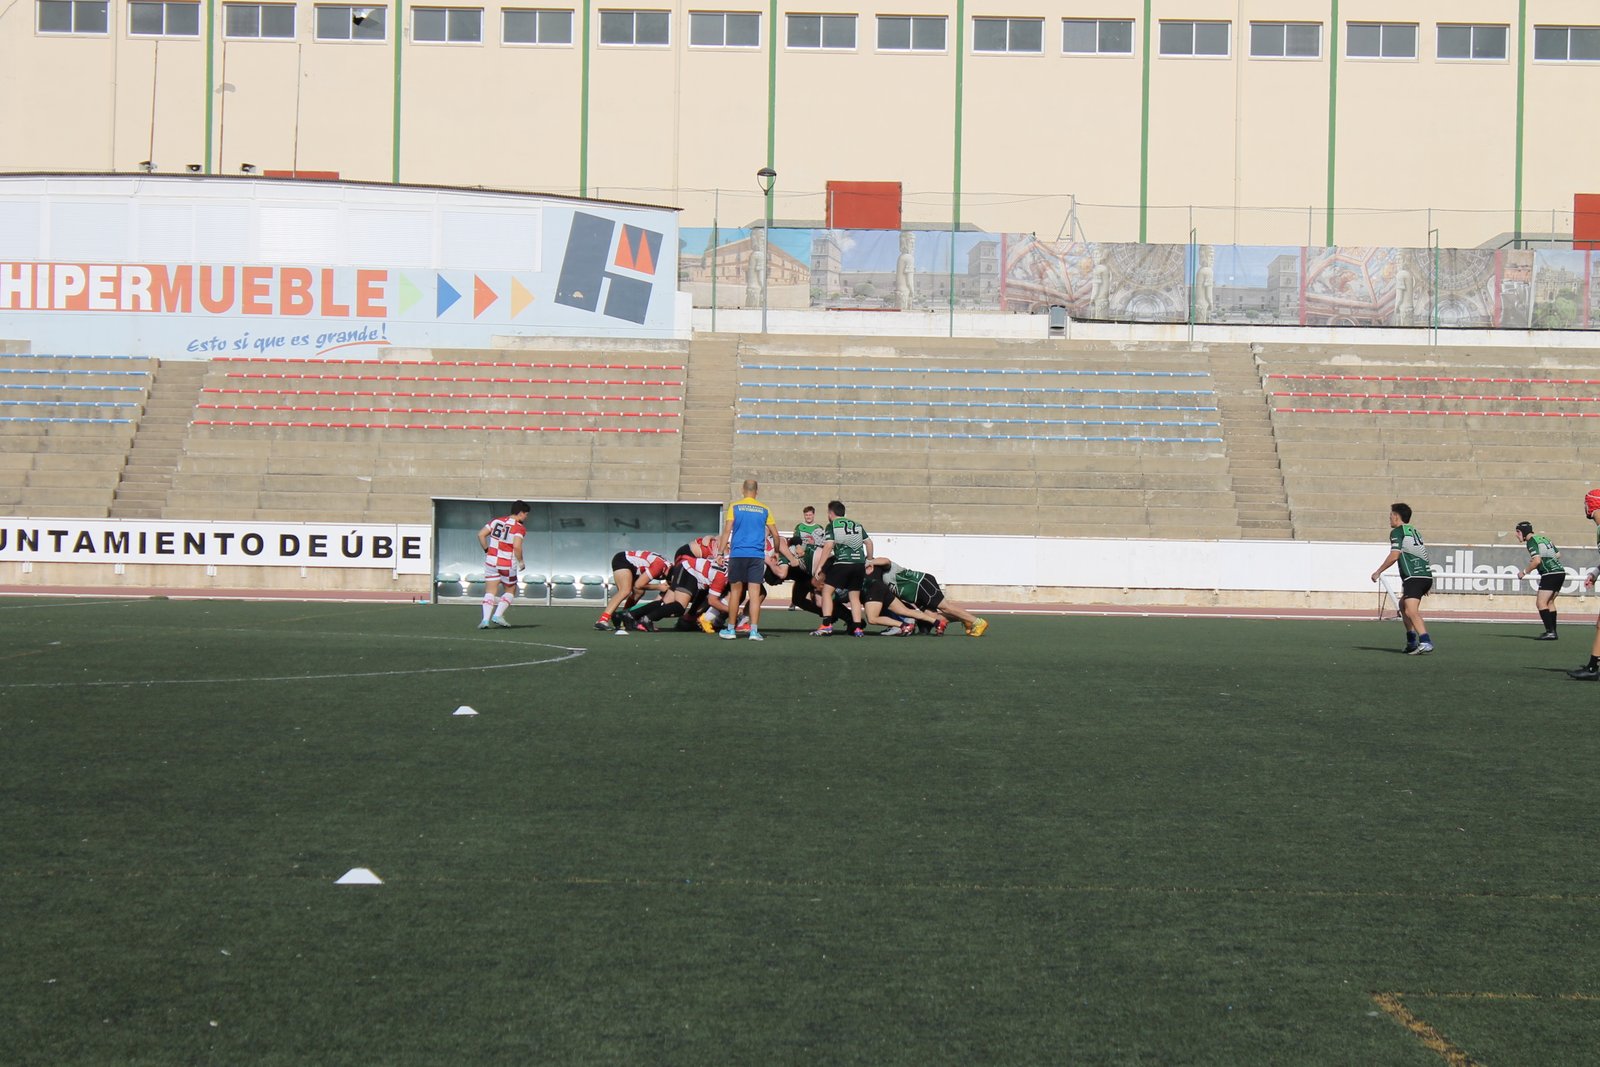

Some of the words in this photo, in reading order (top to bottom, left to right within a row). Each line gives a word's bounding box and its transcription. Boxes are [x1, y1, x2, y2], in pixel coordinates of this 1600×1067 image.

[0, 263, 388, 318] HIPERMUEBLE
[187, 336, 228, 351] Esto
[254, 335, 286, 353] que
[290, 334, 310, 346] es
[315, 323, 387, 348] grande!
[491, 522, 510, 541] 61
[839, 520, 859, 535] 22
[279, 533, 328, 558] DE
